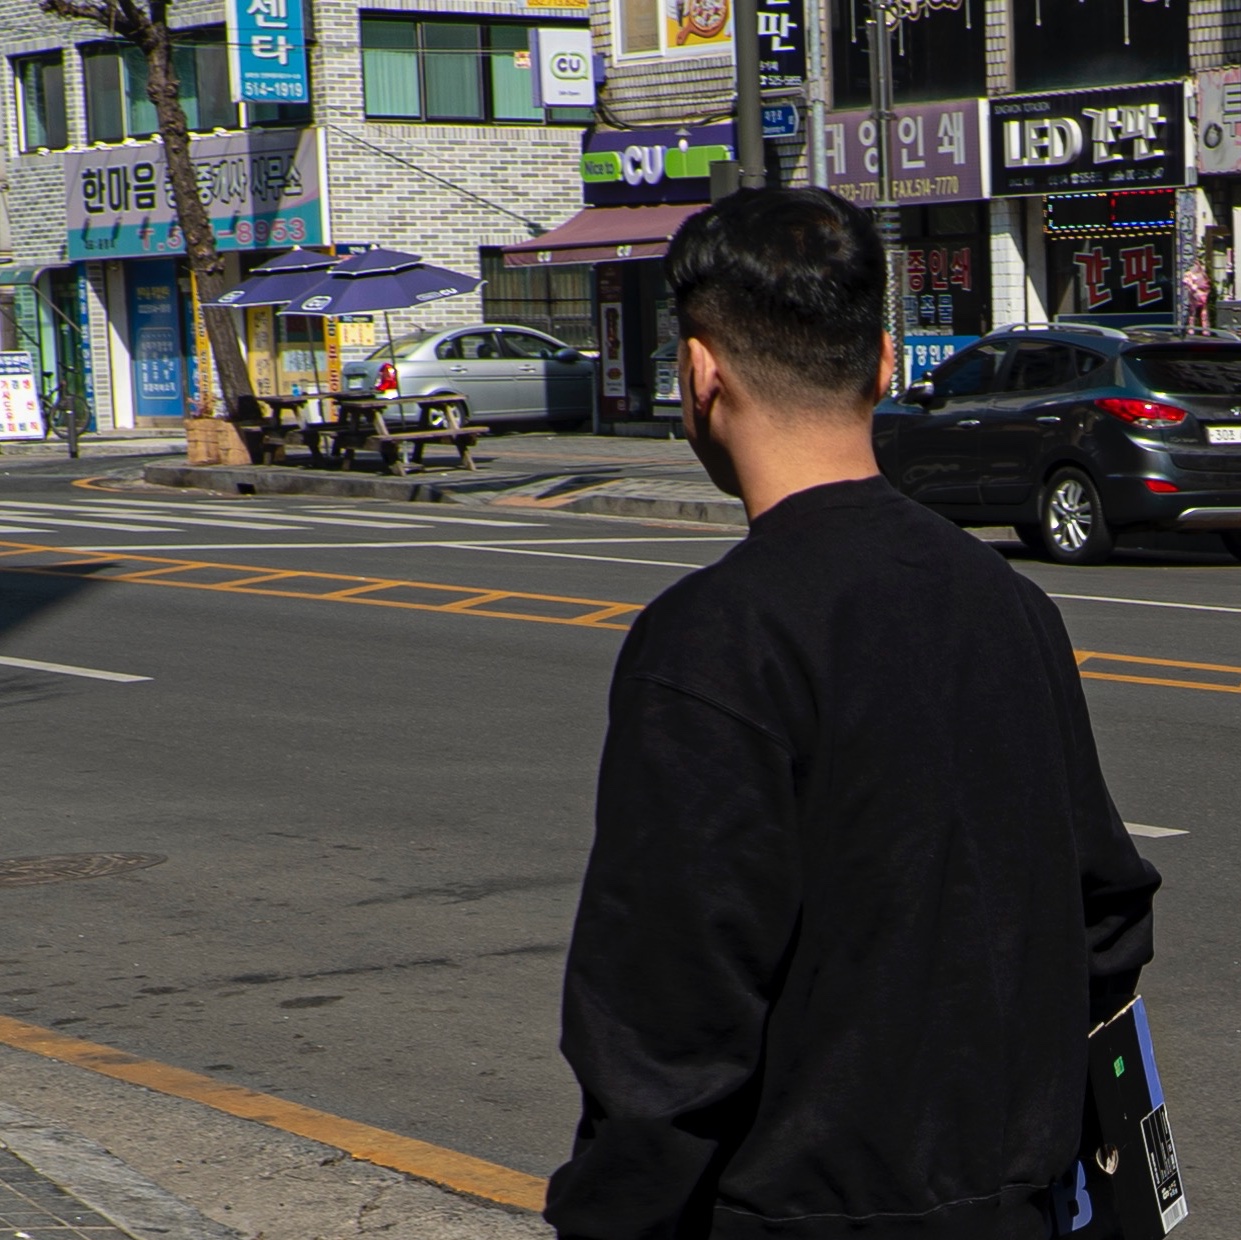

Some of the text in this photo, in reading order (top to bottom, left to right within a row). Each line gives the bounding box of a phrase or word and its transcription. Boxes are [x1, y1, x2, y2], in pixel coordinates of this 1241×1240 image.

[556, 57, 582, 73] CU
[244, 81, 303, 97] 514-1919
[1003, 103, 1168, 168] LED 간판
[82, 161, 157, 214] 한마음
[623, 144, 668, 186] CU
[1073, 244, 1163, 309] 간판
